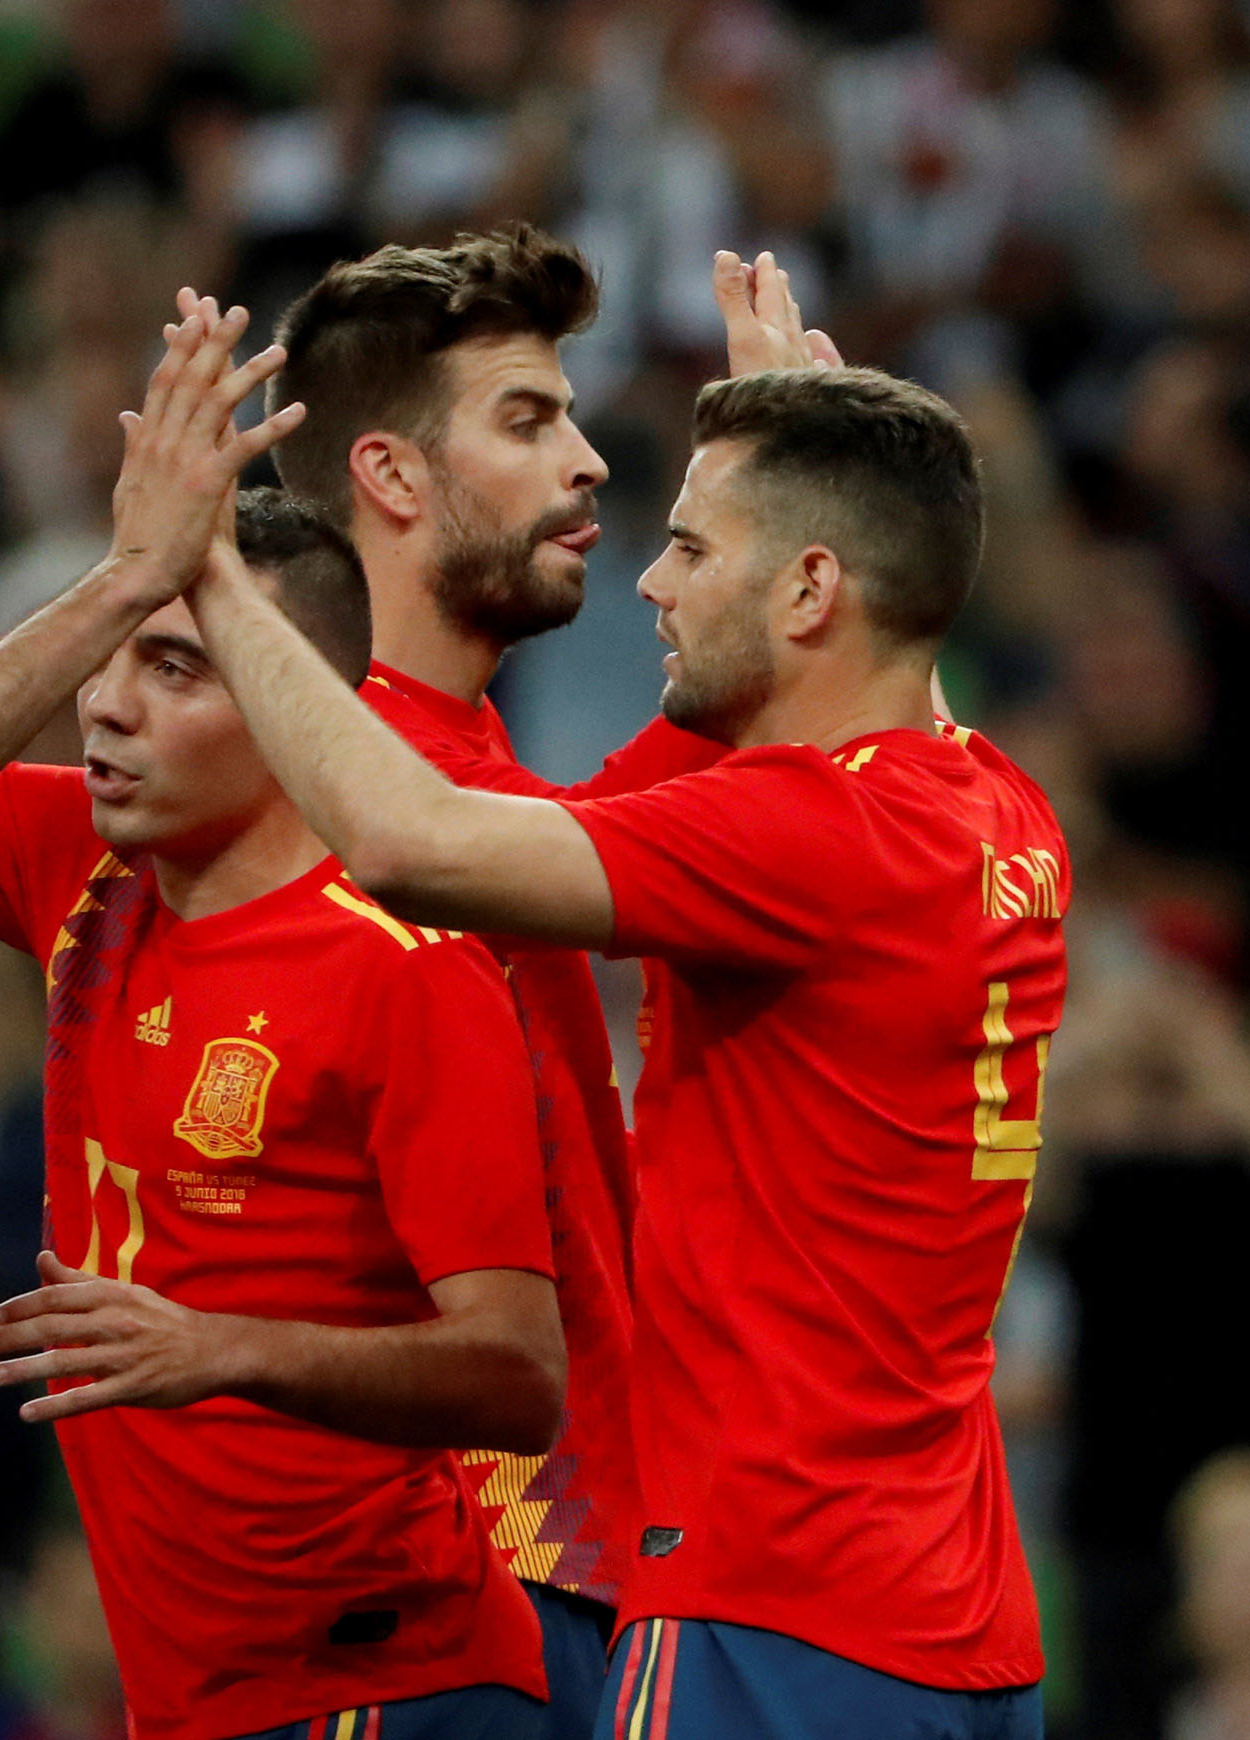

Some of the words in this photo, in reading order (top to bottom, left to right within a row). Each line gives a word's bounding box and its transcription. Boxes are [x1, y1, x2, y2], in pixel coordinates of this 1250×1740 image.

[167, 1169, 204, 1185] ESPAÑA
[206, 1175, 220, 1186] VS
[184, 1186, 218, 1199] JUNIO
